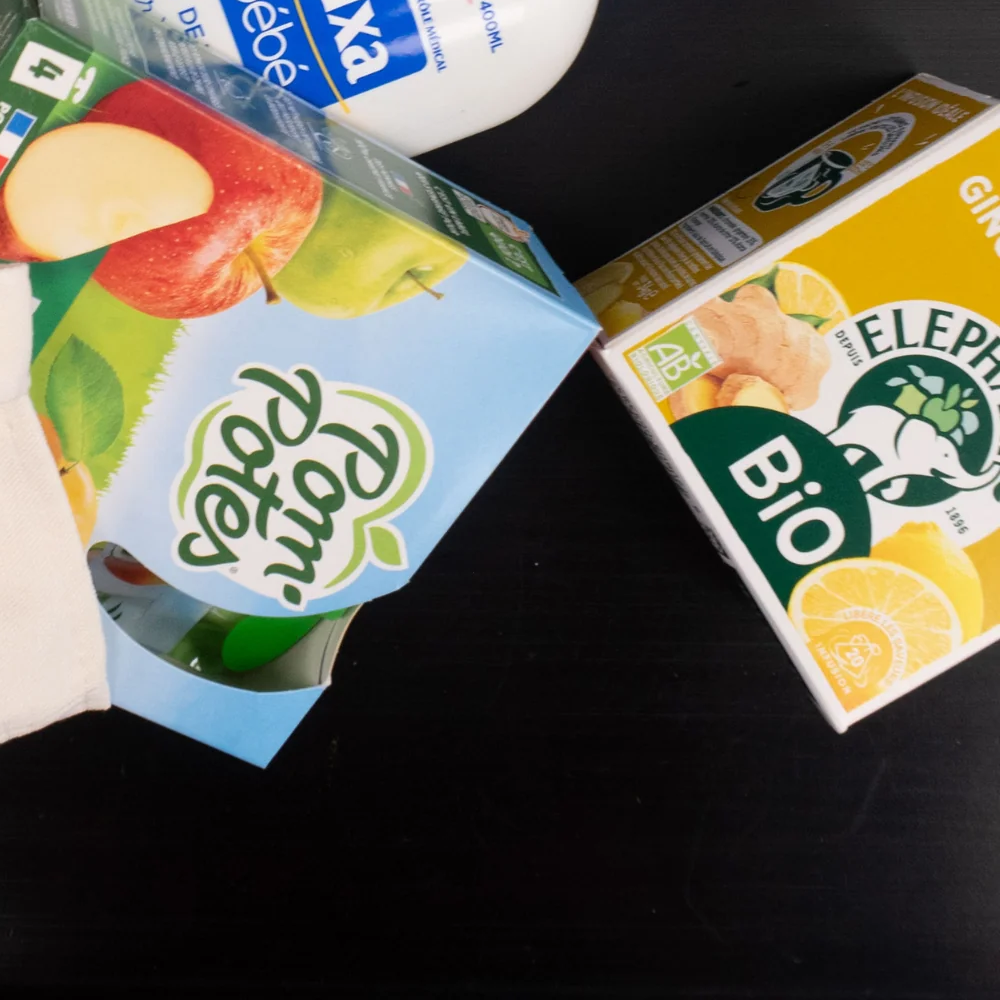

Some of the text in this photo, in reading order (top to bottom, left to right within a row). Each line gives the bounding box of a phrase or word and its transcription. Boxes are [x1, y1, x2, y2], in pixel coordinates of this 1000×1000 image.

[178, 5, 206, 39] DE
[478, 0, 505, 54] 400ML
[27, 58, 65, 82] 4
[424, 23, 447, 74] MÉDICAL
[647, 343, 692, 382] AB
[834, 329, 864, 368] DEPUIS
[855, 308, 1000, 395] ELEPH
[177, 367, 323, 567] Potes
[263, 423, 401, 606] Pom'
[728, 434, 846, 566] BiO
[944, 507, 969, 535] 1896
[814, 642, 852, 696] INFUSION
[846, 648, 865, 668] 20
